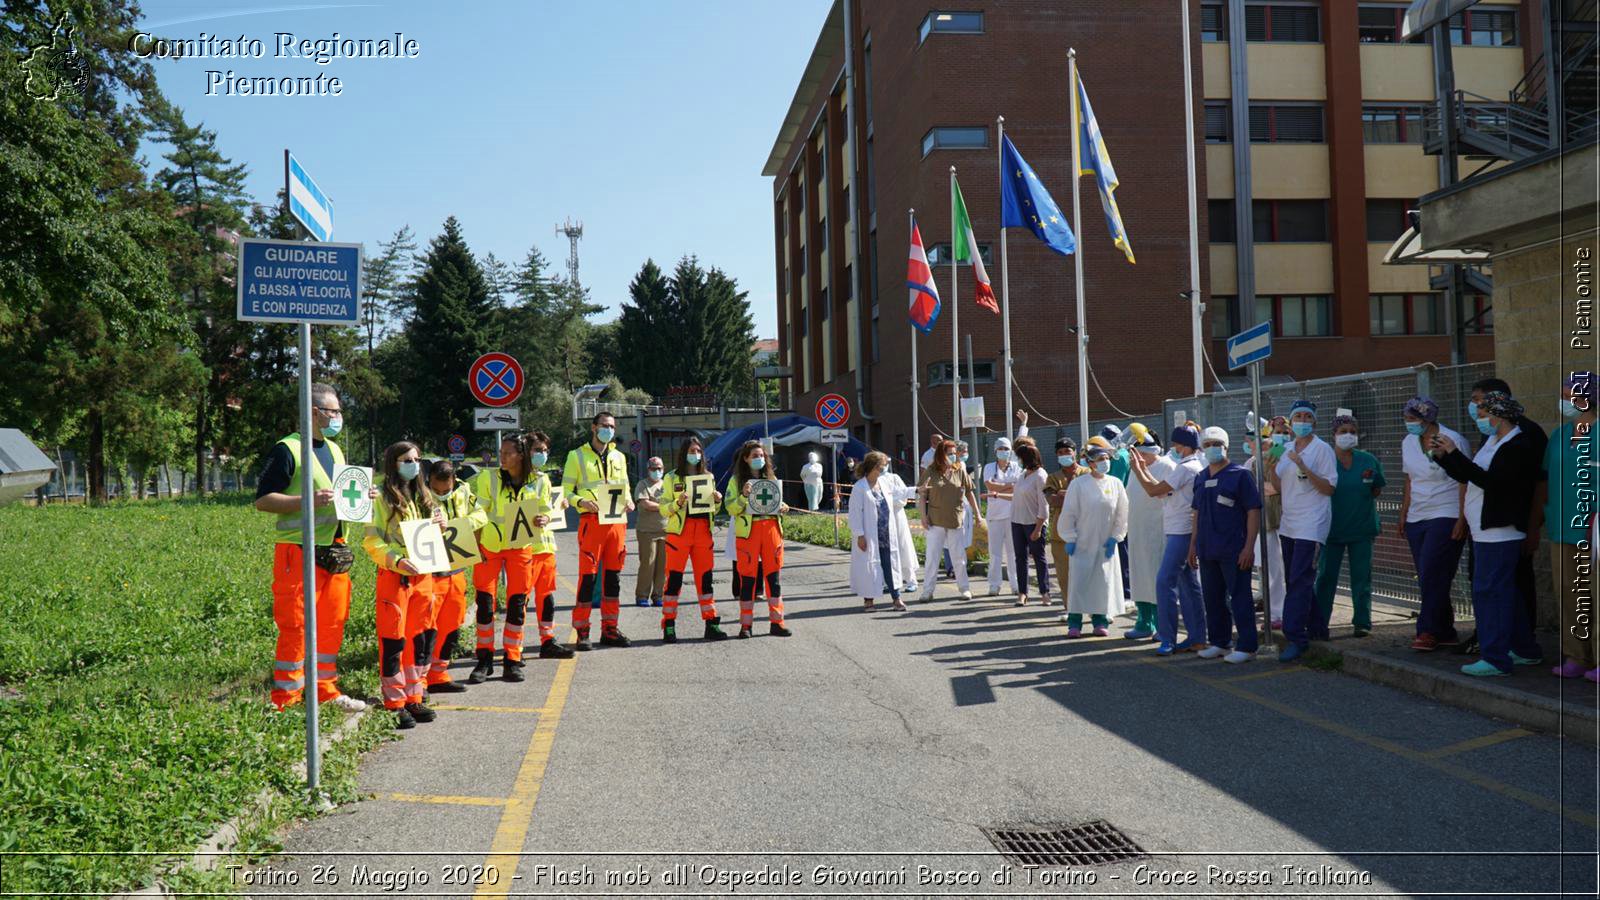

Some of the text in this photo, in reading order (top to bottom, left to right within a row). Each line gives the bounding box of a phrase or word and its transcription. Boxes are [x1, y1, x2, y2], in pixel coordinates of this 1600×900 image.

[265, 248, 338, 264] GUIDARE
[254, 266, 348, 281] GLI AUTOVEICOLI
[248, 283, 352, 299] A BASSA VELOCITÀ
[252, 301, 348, 316] E CON PRUDENZA
[604, 488, 623, 518] I
[691, 479, 711, 508] E
[510, 506, 534, 542] A
[413, 521, 437, 567] G
[442, 525, 476, 563] R
